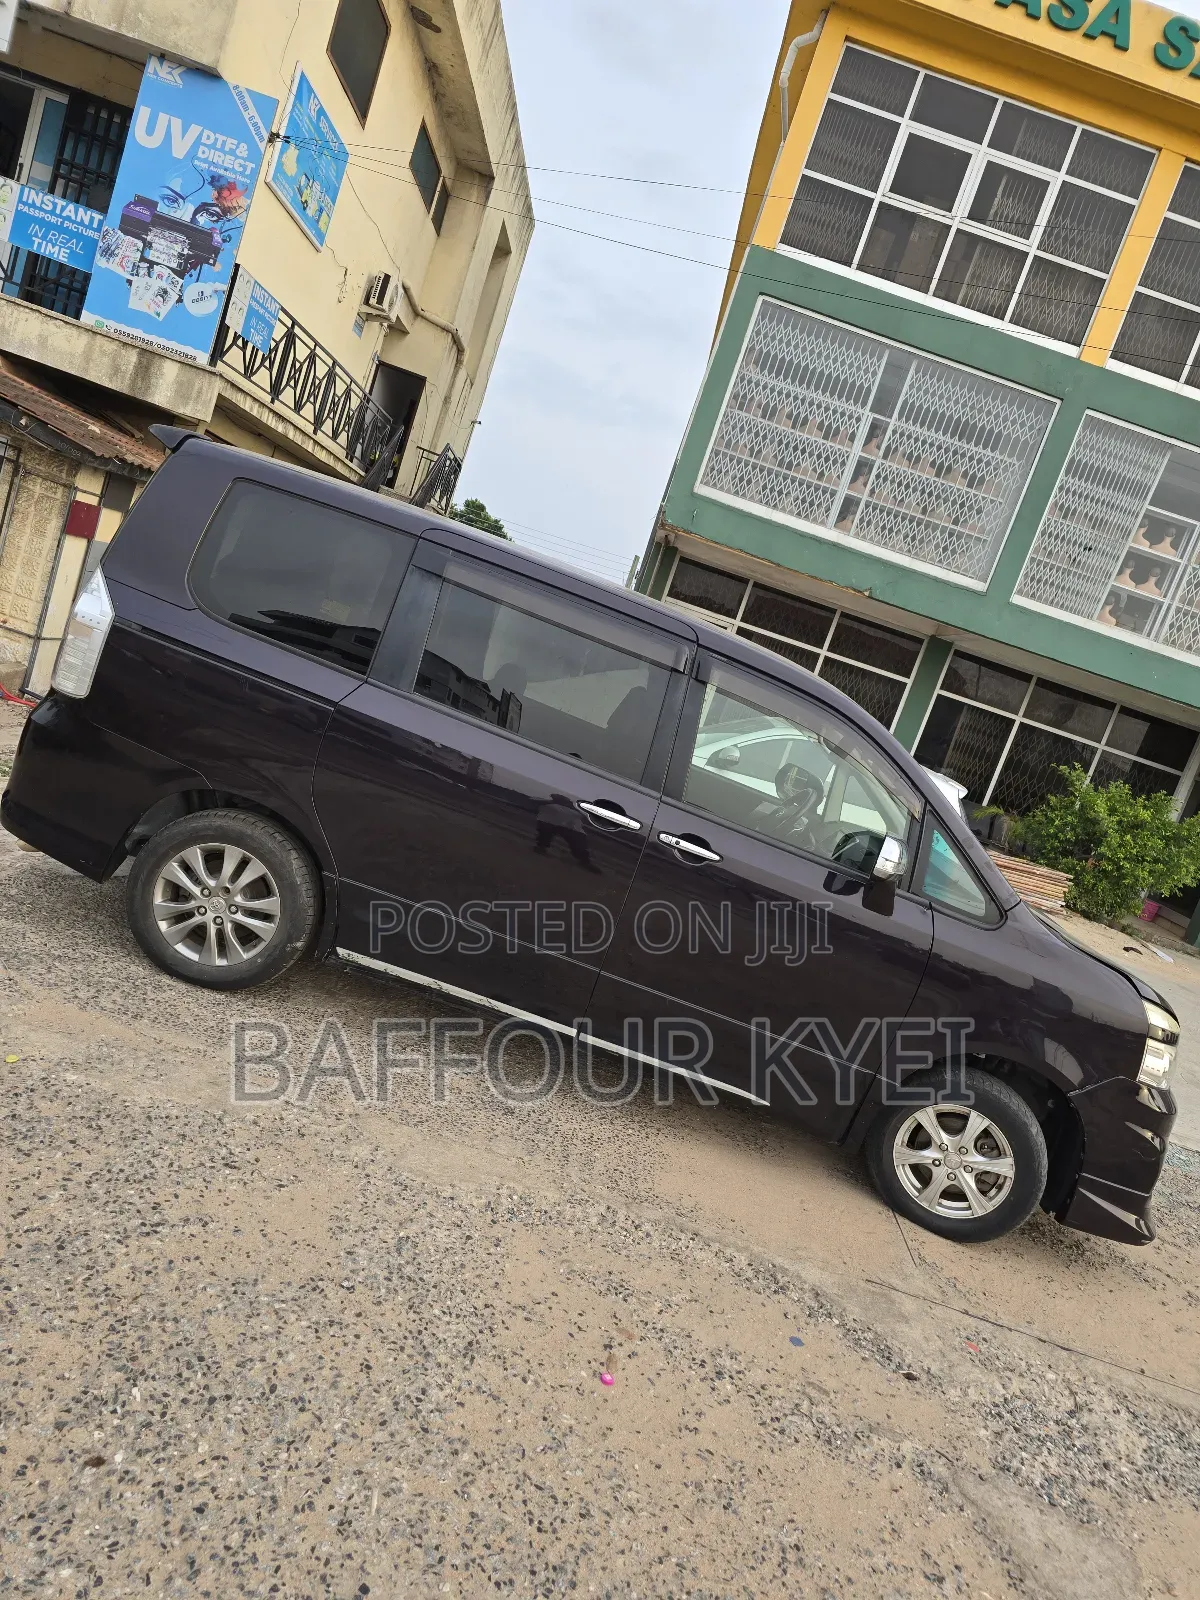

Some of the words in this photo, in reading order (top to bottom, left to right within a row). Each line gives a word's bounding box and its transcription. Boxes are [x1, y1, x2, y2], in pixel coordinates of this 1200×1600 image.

[232, 84, 250, 113] 8:00am
[248, 114, 266, 143] 6:00pm
[134, 105, 203, 159] UV
[197, 144, 256, 175] DIRECT
[17, 203, 63, 226] PASSPORT
[63, 220, 101, 240] PICTURE
[22, 187, 104, 229] INSTANT
[27, 223, 46, 236] IN
[47, 230, 84, 254] REAL
[32, 236, 71, 262] TIME
[252, 283, 281, 316] INSTANT
